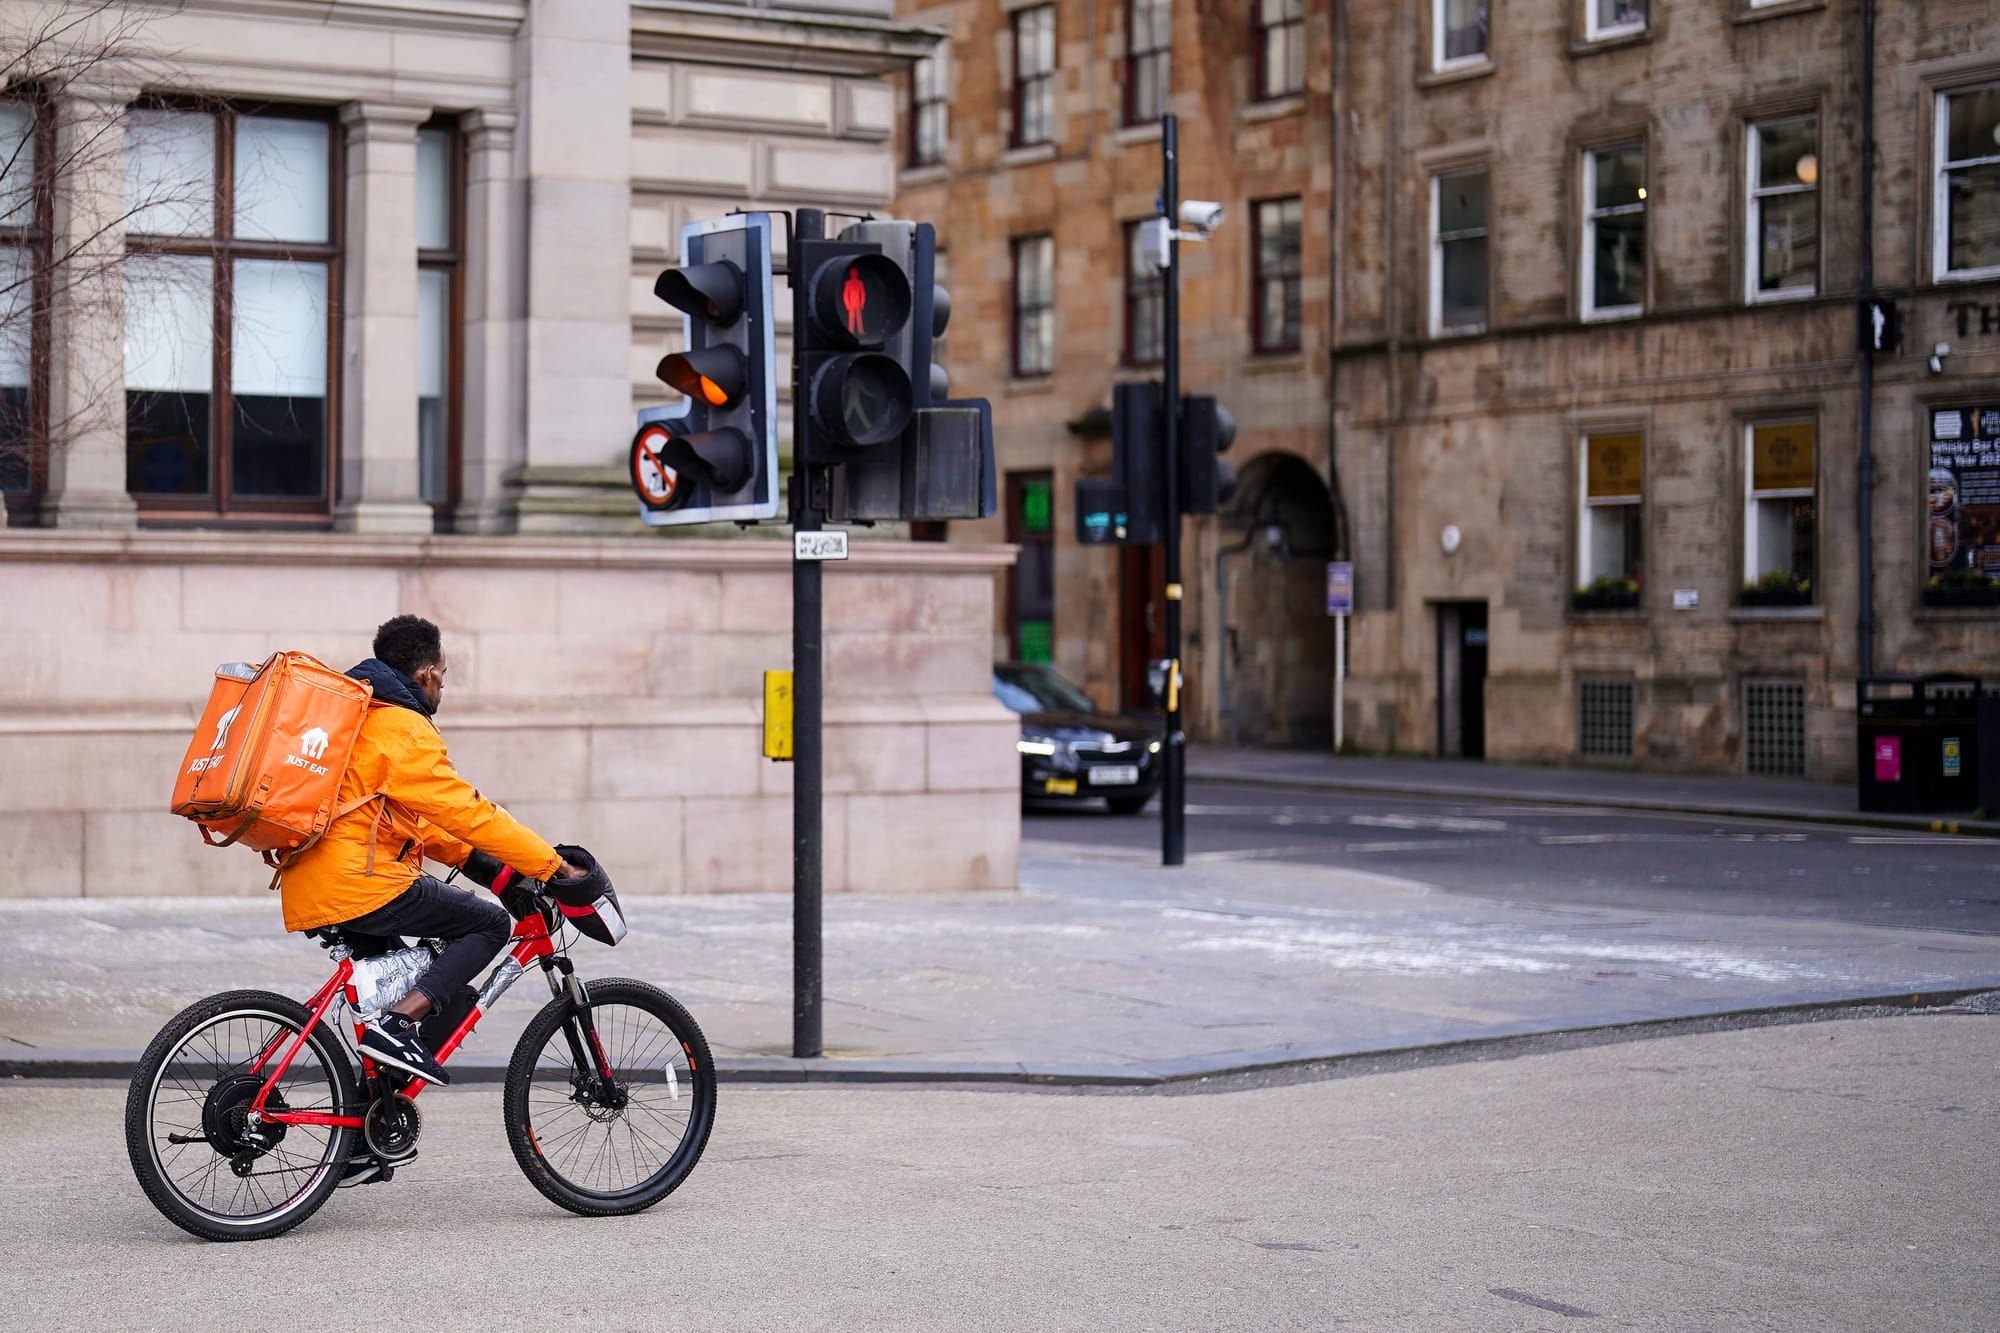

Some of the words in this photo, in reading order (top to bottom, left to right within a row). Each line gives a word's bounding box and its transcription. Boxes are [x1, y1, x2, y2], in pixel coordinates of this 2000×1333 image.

[1972, 438, 1992, 453] Bar
[1954, 454, 1977, 467] Year
[187, 757, 211, 775] JUST
[207, 755, 225, 769] EAT
[284, 754, 310, 769] JUST
[309, 763, 329, 776] EAT
